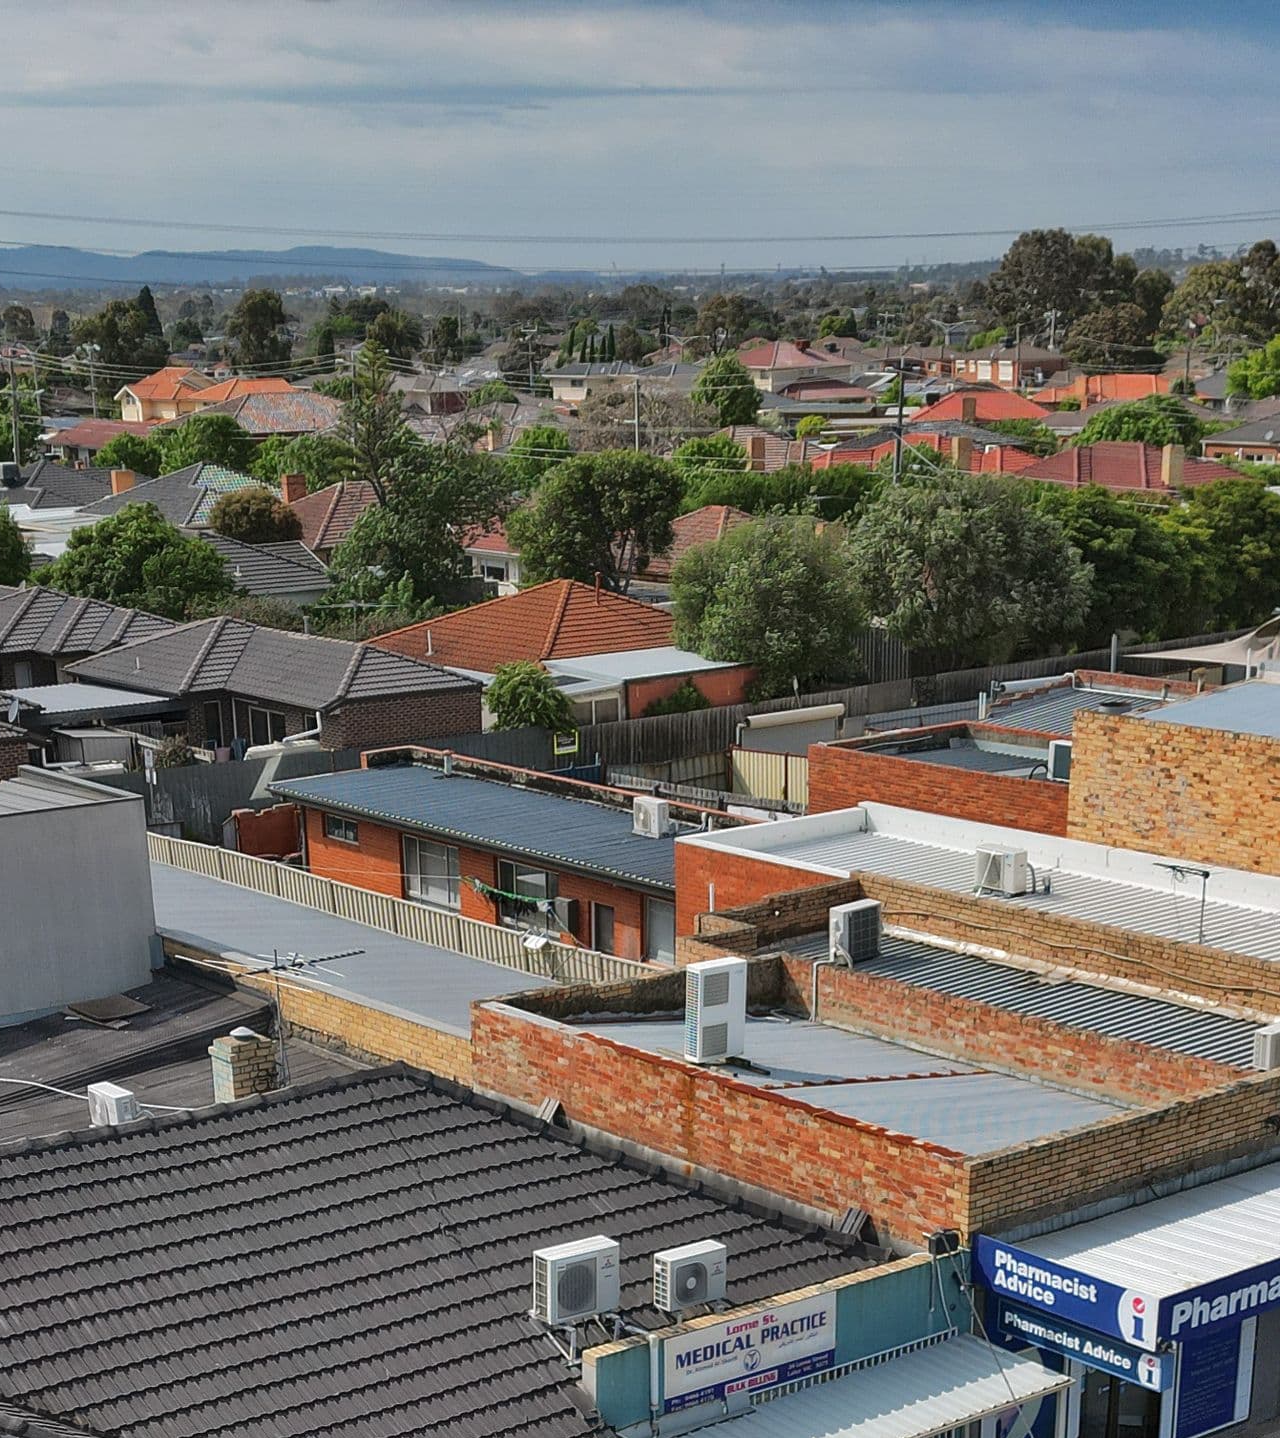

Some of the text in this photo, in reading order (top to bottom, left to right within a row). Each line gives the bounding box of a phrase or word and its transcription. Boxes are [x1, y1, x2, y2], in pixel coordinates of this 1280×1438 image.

[994, 1249, 1098, 1303] Pharmacist
[994, 1268, 1055, 1306] Advice
[675, 1334, 755, 1370] MEDICAL
[761, 1311, 827, 1345] PRACTICE
[726, 1314, 778, 1336] Lorne St.
[1004, 1310, 1132, 1370] Pharmacist Advice
